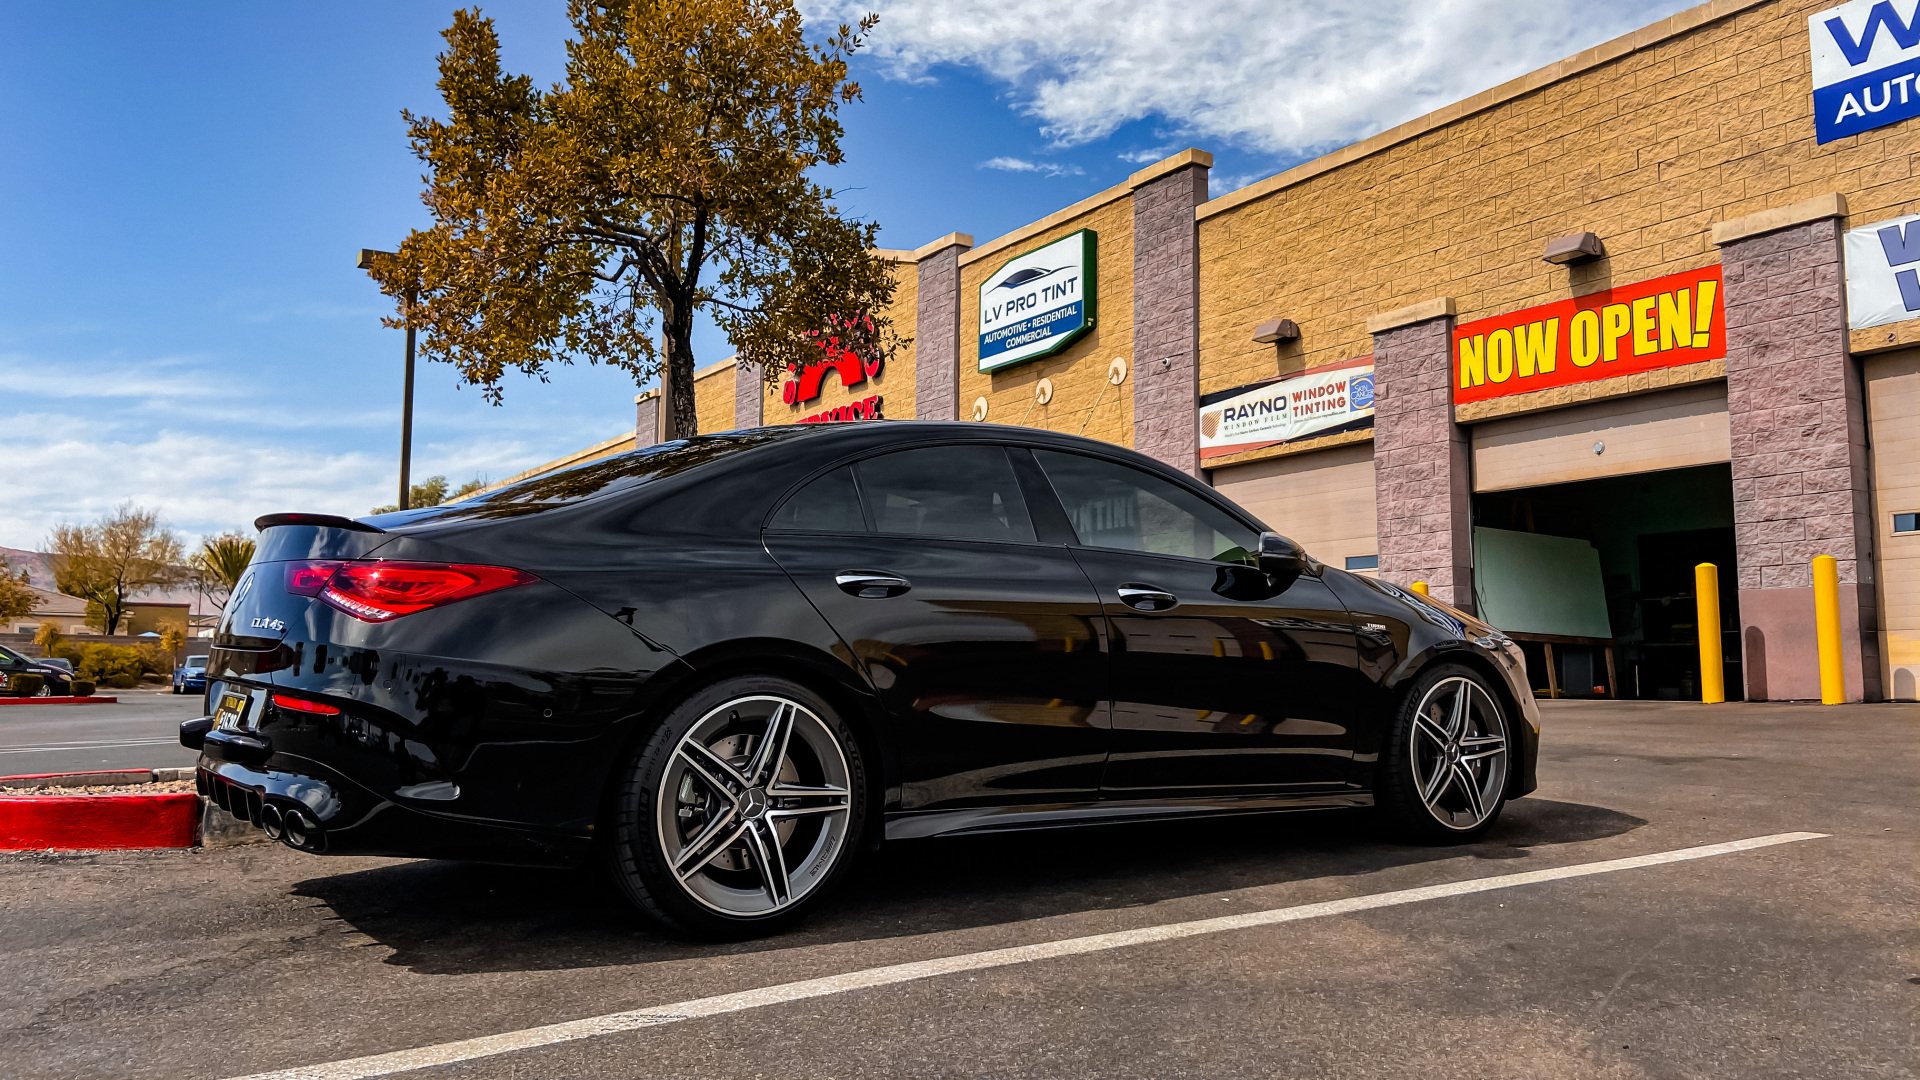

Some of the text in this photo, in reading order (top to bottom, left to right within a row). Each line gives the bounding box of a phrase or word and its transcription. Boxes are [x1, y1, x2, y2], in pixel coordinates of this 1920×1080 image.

[1834, 73, 1920, 125] AUT
[984, 276, 1078, 325] LV PRO TINT
[984, 305, 1078, 345] AUTOMOTIVE RESIDENTIAL
[1005, 326, 1053, 349] COMMERCIAL
[1458, 279, 1719, 390] NOW OPEN!
[1292, 381, 1347, 403] WINDOW
[1224, 395, 1287, 423] RAYNO
[1293, 397, 1346, 418] TINTING
[1223, 418, 1260, 431] WINDOW
[1264, 413, 1287, 424] FILM
